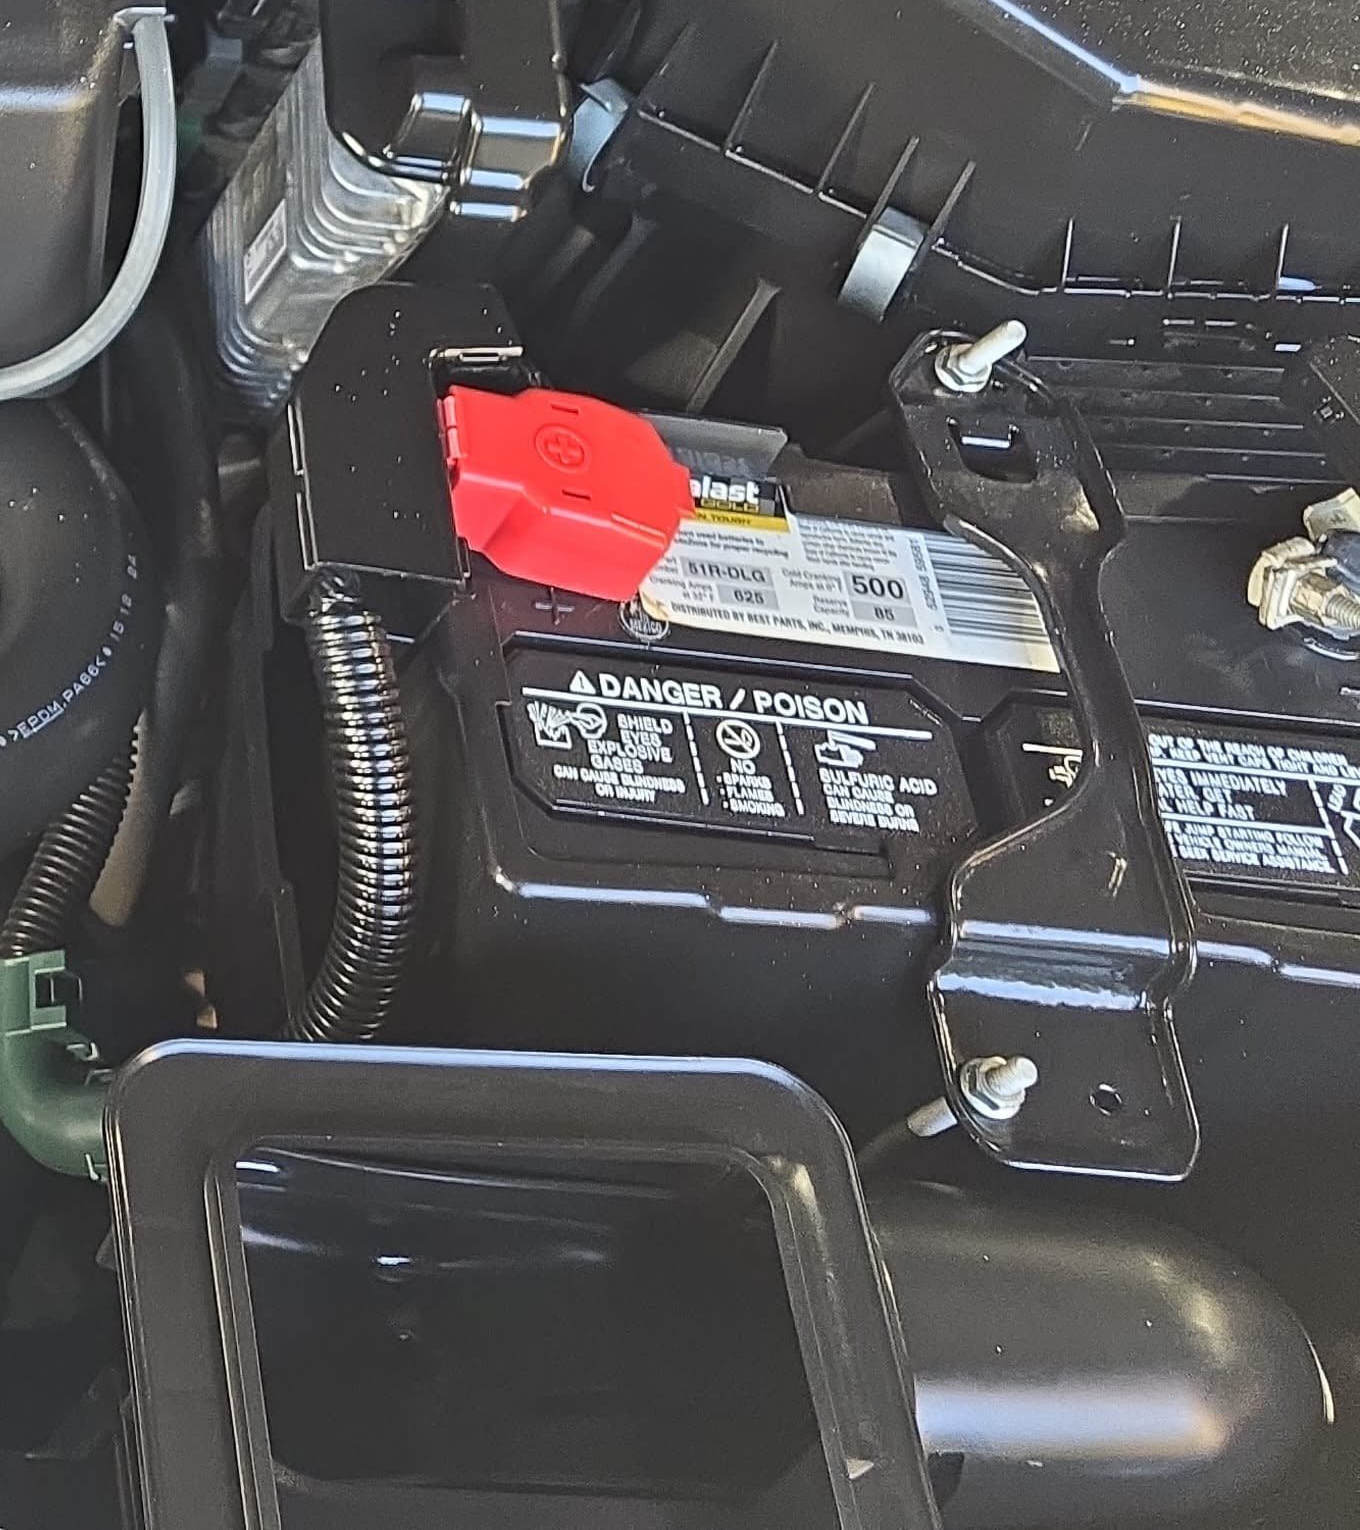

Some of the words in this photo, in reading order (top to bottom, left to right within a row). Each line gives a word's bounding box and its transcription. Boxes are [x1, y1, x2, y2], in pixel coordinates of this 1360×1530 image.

[690, 474, 760, 504] alast
[700, 498, 760, 513] GOLD
[688, 561, 766, 583] 51R-DLG
[852, 575, 904, 600] 500
[670, 601, 731, 621] DISTRIBUTED
[731, 609, 746, 622] BY
[747, 612, 771, 626] BEST
[772, 614, 807, 631] PARTS,
[832, 624, 880, 640] MEMPHIS,
[881, 630, 894, 641] TN
[599, 673, 723, 709] DANGER
[729, 688, 746, 710] /
[752, 689, 870, 725] POISON
[616, 714, 673, 734] SHIELD
[620, 729, 662, 747] EYES
[1148, 734, 1175, 750] OUT
[1197, 738, 1223, 755] THE
[1224, 741, 1267, 761] REACH
[586, 740, 673, 763] EXPLOSIVE
[590, 755, 644, 774] GASES
[730, 758, 756, 775] NO
[553, 765, 579, 781] CAN
[579, 769, 619, 785] CAUSE
[620, 773, 686, 794] BLINDNESS
[723, 772, 773, 790] SPARKS
[819, 768, 895, 792] SULFURIC
[899, 776, 938, 796] ACID
[1190, 770, 1288, 797] IMMEDIATELY
[595, 783, 615, 797] OR
[616, 786, 657, 803] INJURY
[726, 785, 775, 803] FLAMES
[823, 783, 851, 798] CAN
[851, 786, 895, 804] CAUSE
[1202, 789, 1234, 804] GET
[729, 797, 786, 818] SMOKING
[827, 796, 894, 816] BLINDNESS
[894, 803, 915, 818] OR
[830, 809, 877, 827] SEVERE
[1176, 799, 1215, 817] HELP
[1218, 803, 1256, 821] FAST
[1184, 823, 1216, 837] JUMP
[1274, 831, 1325, 849] FOLLOW
